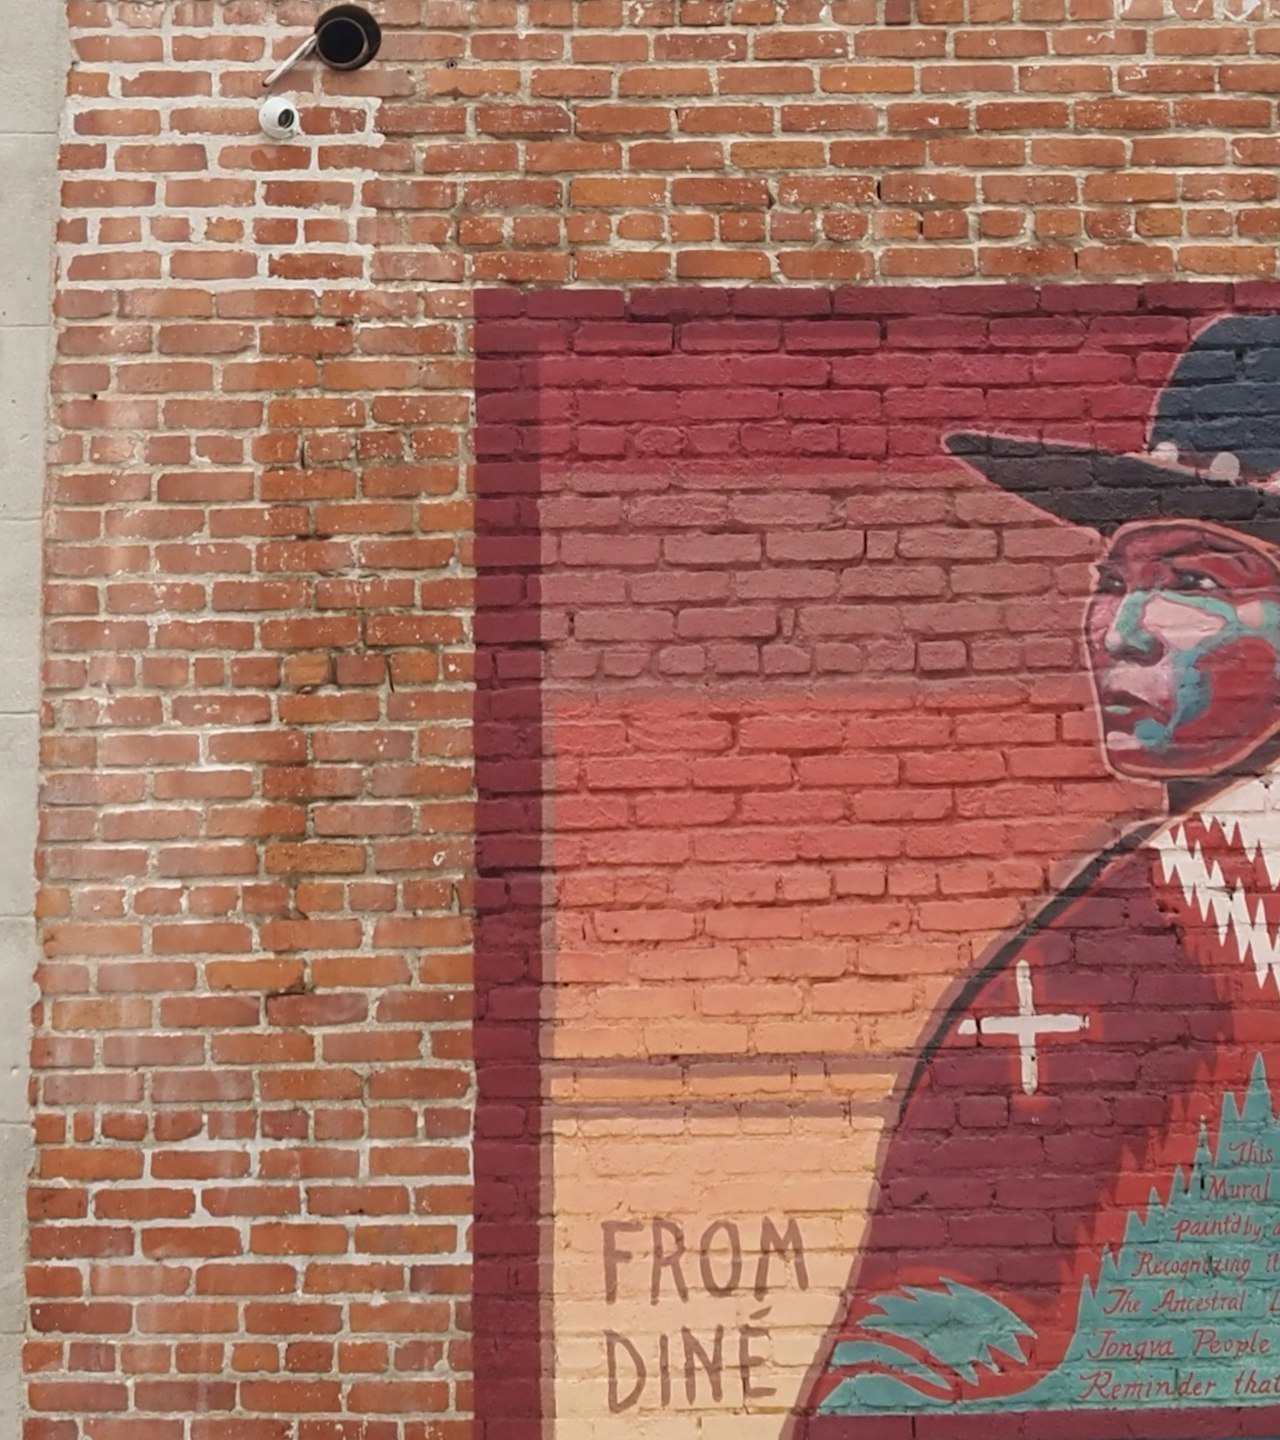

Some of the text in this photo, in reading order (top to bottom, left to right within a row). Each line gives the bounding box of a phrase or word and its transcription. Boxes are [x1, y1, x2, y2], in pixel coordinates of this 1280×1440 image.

[1229, 1139, 1274, 1166] This
[1204, 1173, 1271, 1201] Mural
[1243, 1218, 1263, 1242] by
[600, 1216, 809, 1307] FROM
[1132, 1250, 1252, 1280] Recognizing
[1266, 1252, 1280, 1273] it
[1102, 1288, 1142, 1315] The
[1152, 1289, 1248, 1314] Ancestral
[1191, 1328, 1271, 1361] People
[603, 1306, 780, 1413] DINÉ
[1078, 1371, 1218, 1400] Reminder
